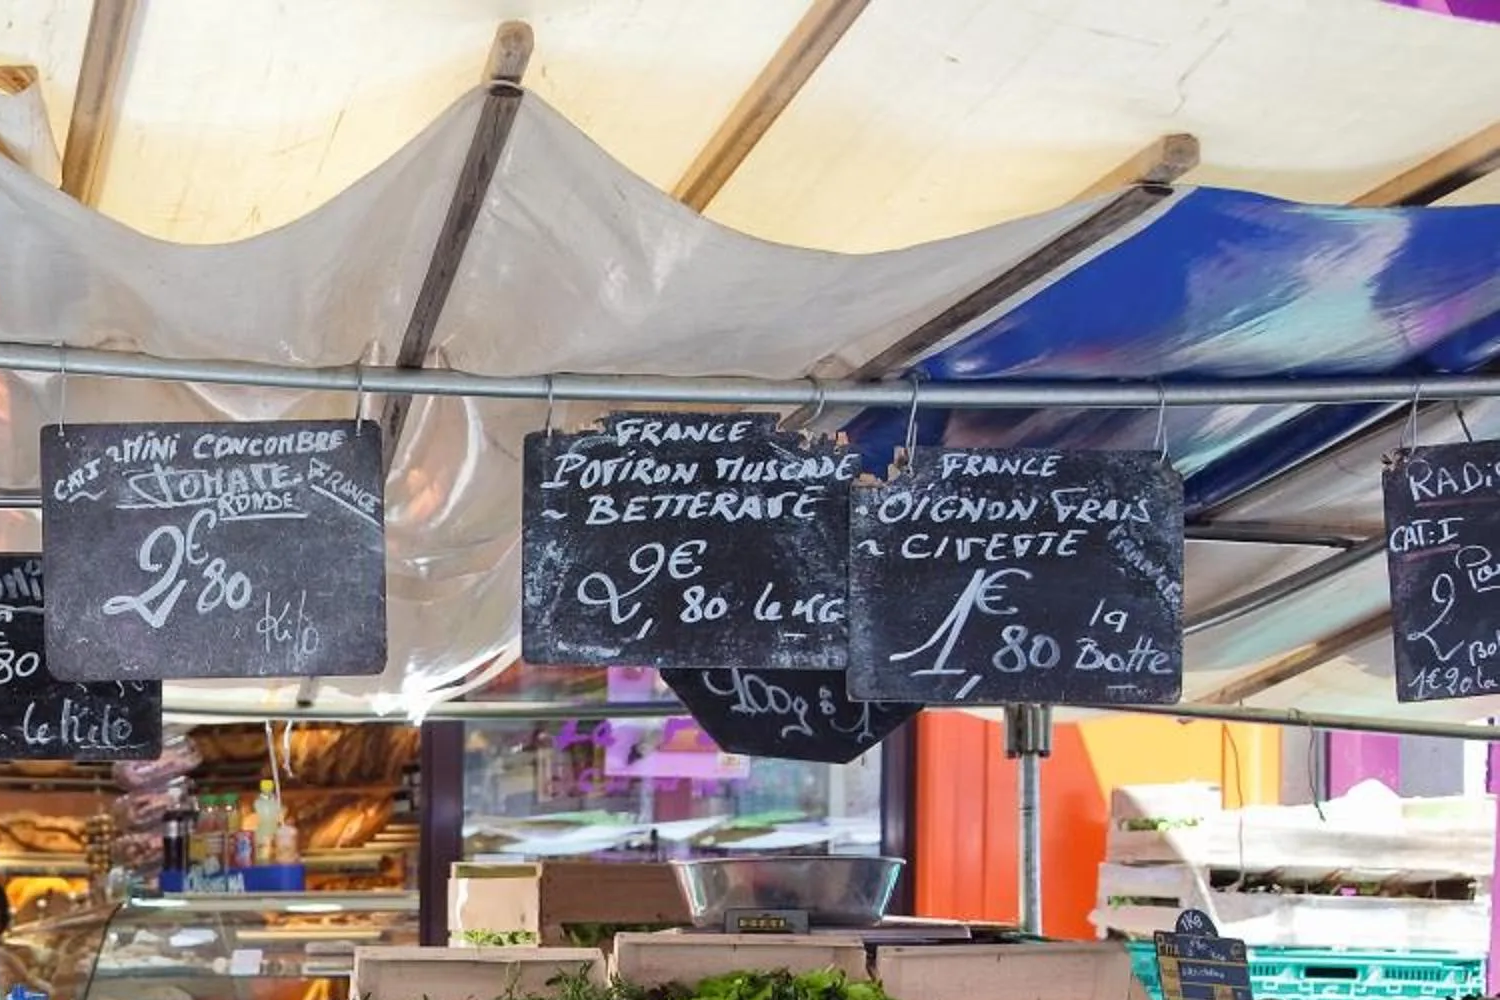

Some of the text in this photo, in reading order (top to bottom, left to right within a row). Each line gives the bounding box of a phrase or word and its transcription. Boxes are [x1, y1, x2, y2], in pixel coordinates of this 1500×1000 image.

[193, 430, 347, 460] CONCOMBRE
[615, 418, 753, 448] FRANCE
[716, 453, 861, 482] MUSCADE
[942, 453, 1063, 480] FRANCE
[217, 492, 294, 518] RONDE
[586, 486, 825, 525] BETTERAVE
[877, 491, 1039, 524] OIGNON
[901, 529, 1088, 562] CIVETTE
